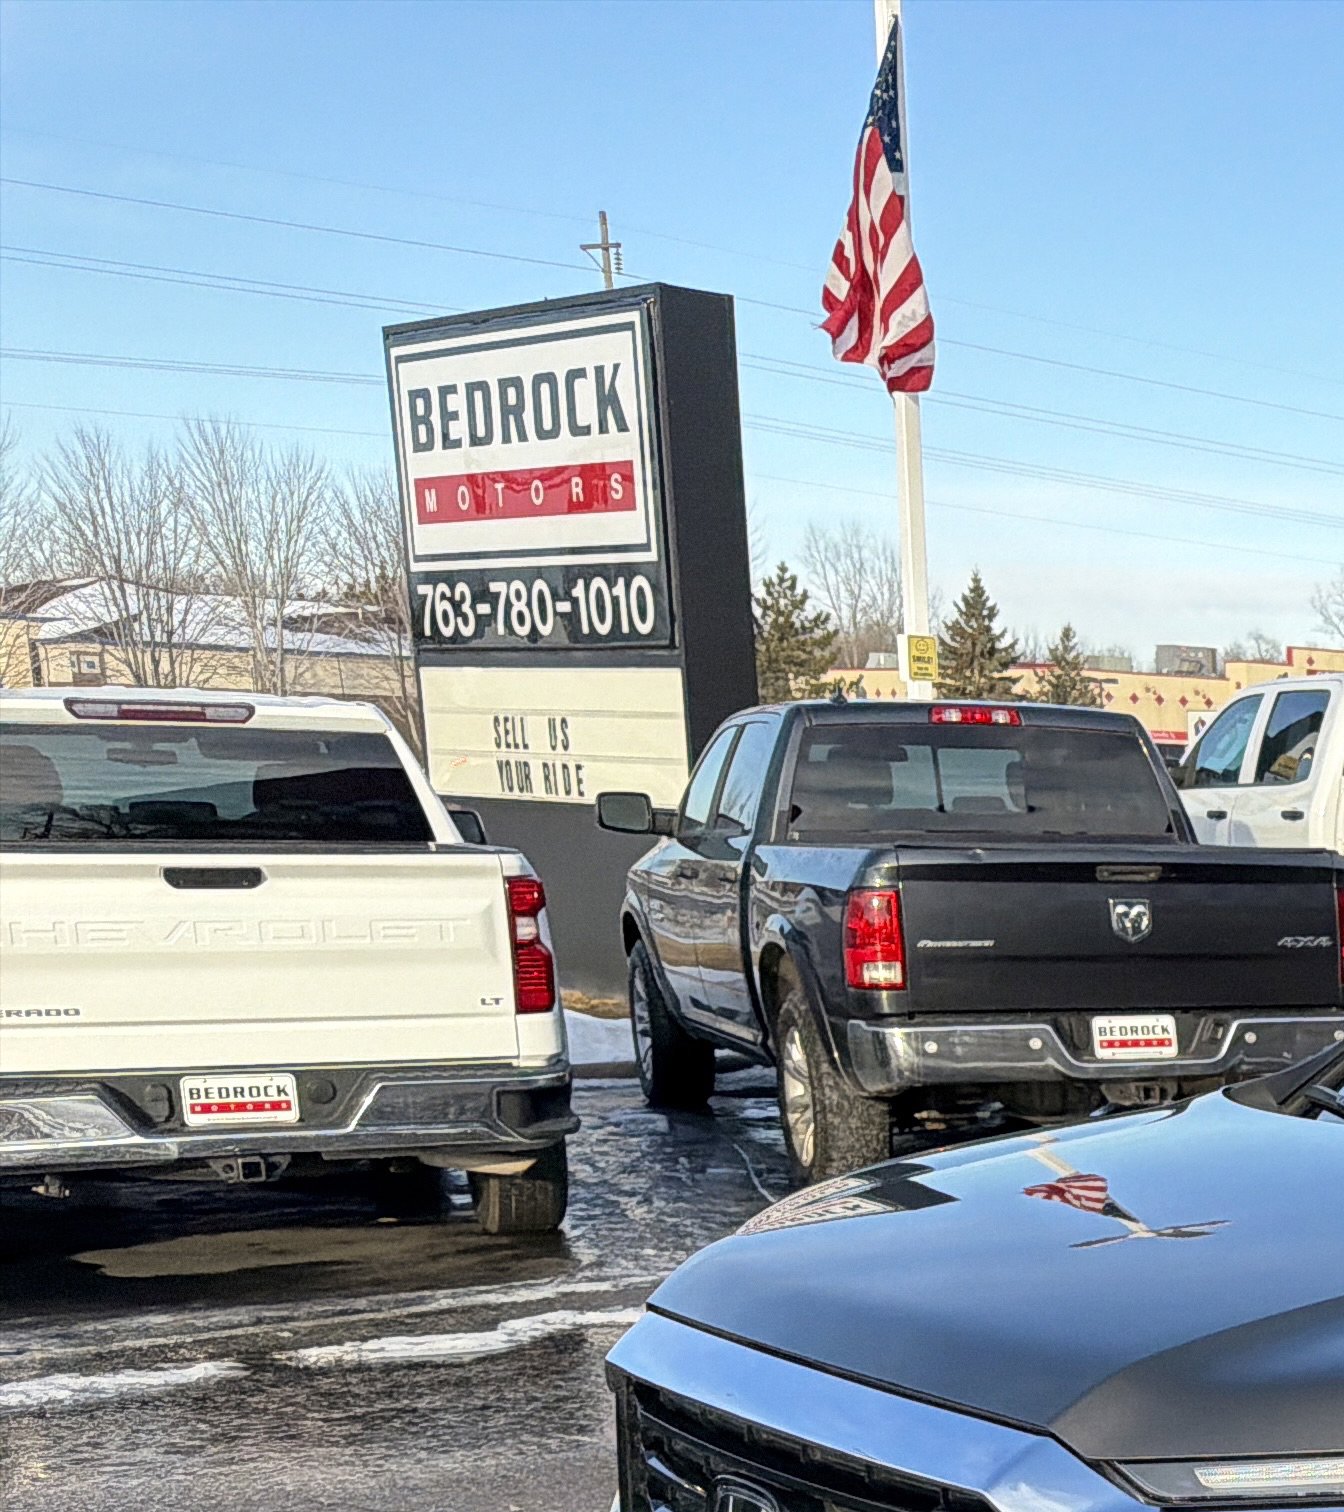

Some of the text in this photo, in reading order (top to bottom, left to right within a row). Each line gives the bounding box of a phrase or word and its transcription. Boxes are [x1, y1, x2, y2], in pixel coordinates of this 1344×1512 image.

[407, 362, 631, 453] BEDROCK
[424, 473, 624, 513] MOTORS
[416, 575, 656, 637] 763-780-1010
[493, 715, 570, 751] SELL US
[496, 759, 585, 797] YOUR RIDE
[0, 917, 472, 948] HEVROLET
[0, 1008, 81, 1019] RADO
[480, 996, 504, 1007] LT
[1098, 1025, 1170, 1037] BEDROCK
[188, 1085, 290, 1100] BEDROCK
